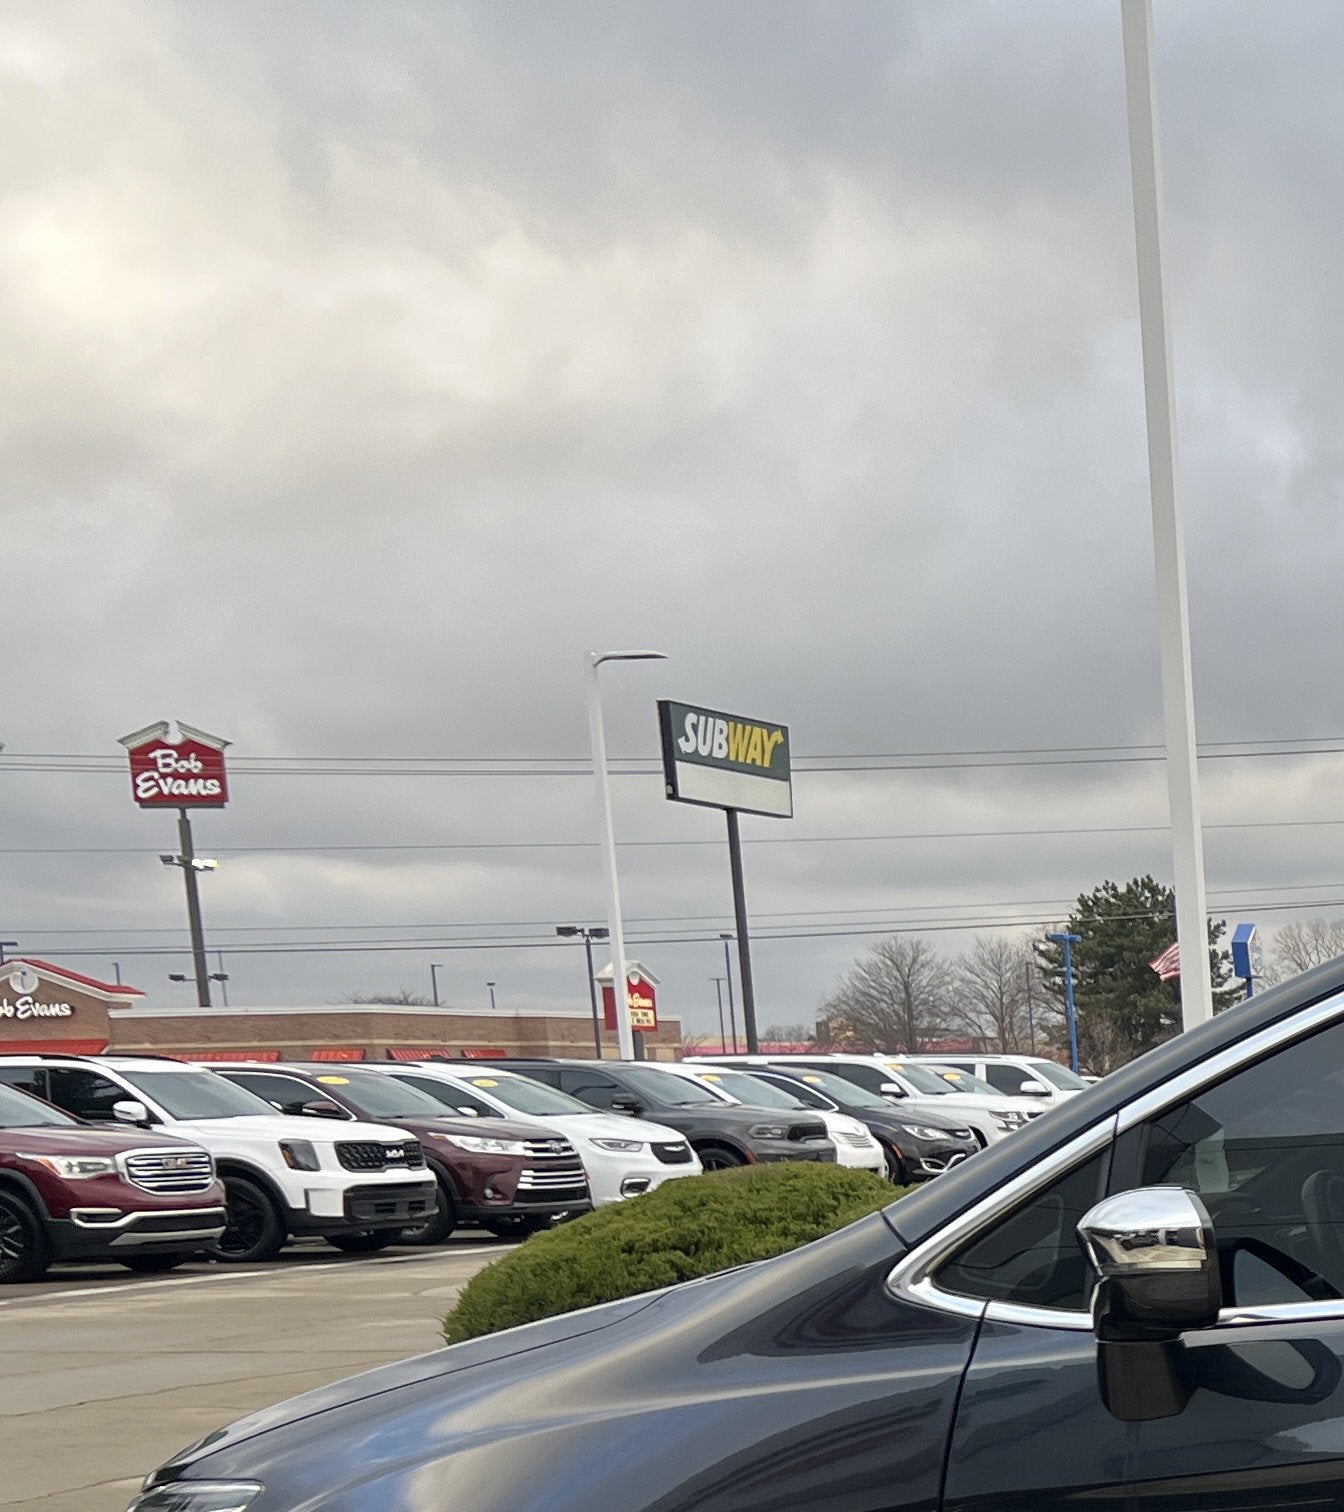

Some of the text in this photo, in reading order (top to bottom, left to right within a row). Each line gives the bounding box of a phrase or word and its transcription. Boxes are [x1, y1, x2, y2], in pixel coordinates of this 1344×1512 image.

[678, 712, 784, 768] SUBWAY
[148, 748, 203, 773] Bob
[135, 770, 221, 799] Evans
[15, 995, 72, 1019] Evans
